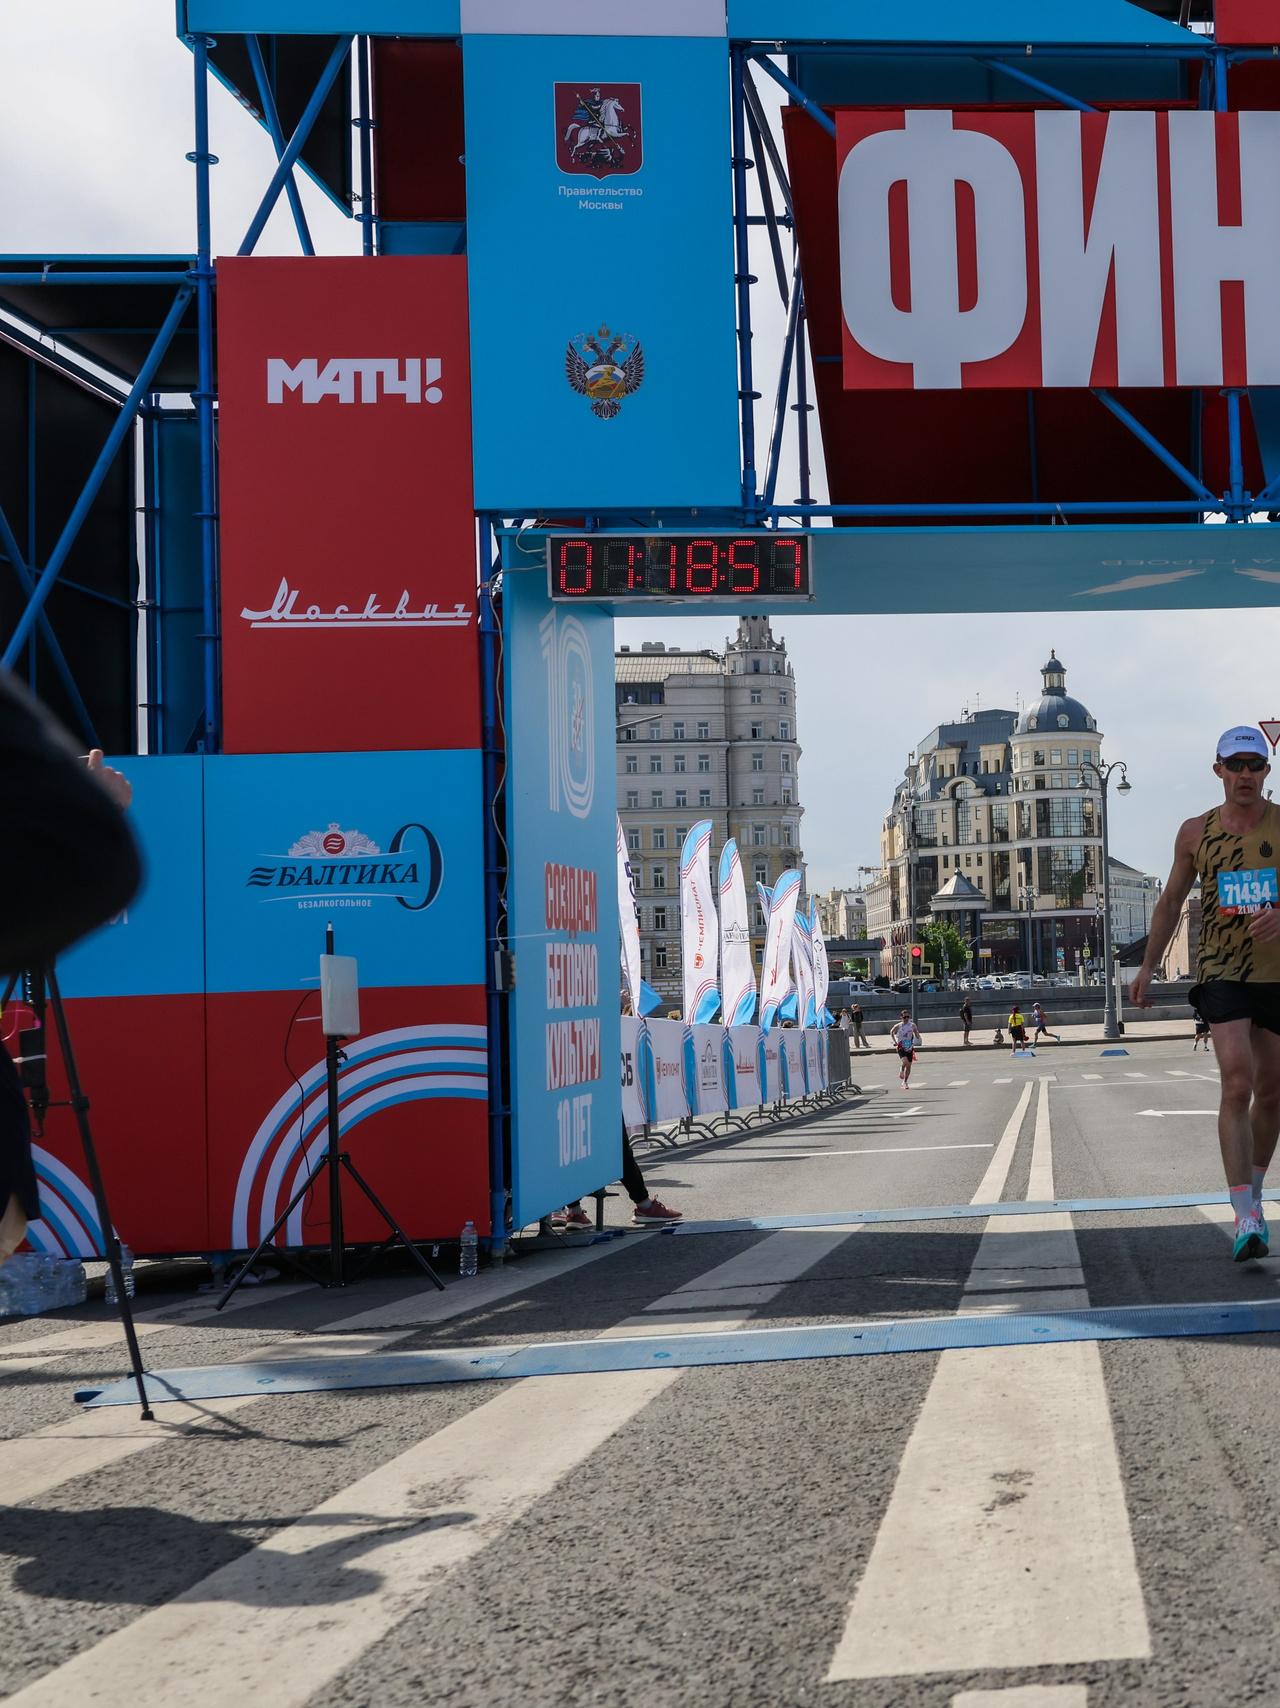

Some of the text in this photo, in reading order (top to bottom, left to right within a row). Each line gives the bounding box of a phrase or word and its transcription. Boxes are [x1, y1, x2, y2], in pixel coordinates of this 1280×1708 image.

[558, 186, 643, 198] Правительство
[579, 200, 623, 210] Москвы
[267, 358, 443, 404] МАТЧ!
[560, 540, 801, 594] 01:18:57
[275, 863, 419, 887] БАЛТИКА
[1224, 881, 1272, 905] 71434
[298, 899, 372, 909] БЕЗАЛКОГОЛЬНОЕ
[545, 861, 597, 939] СОЗДАЕМ
[546, 942, 598, 1010] БЕГОВУЮ
[546, 1018, 600, 1091] КУЛЬТУРУ
[621, 1052, 633, 1087] СБ
[557, 1093, 593, 1167] 10 ЛЕТ
